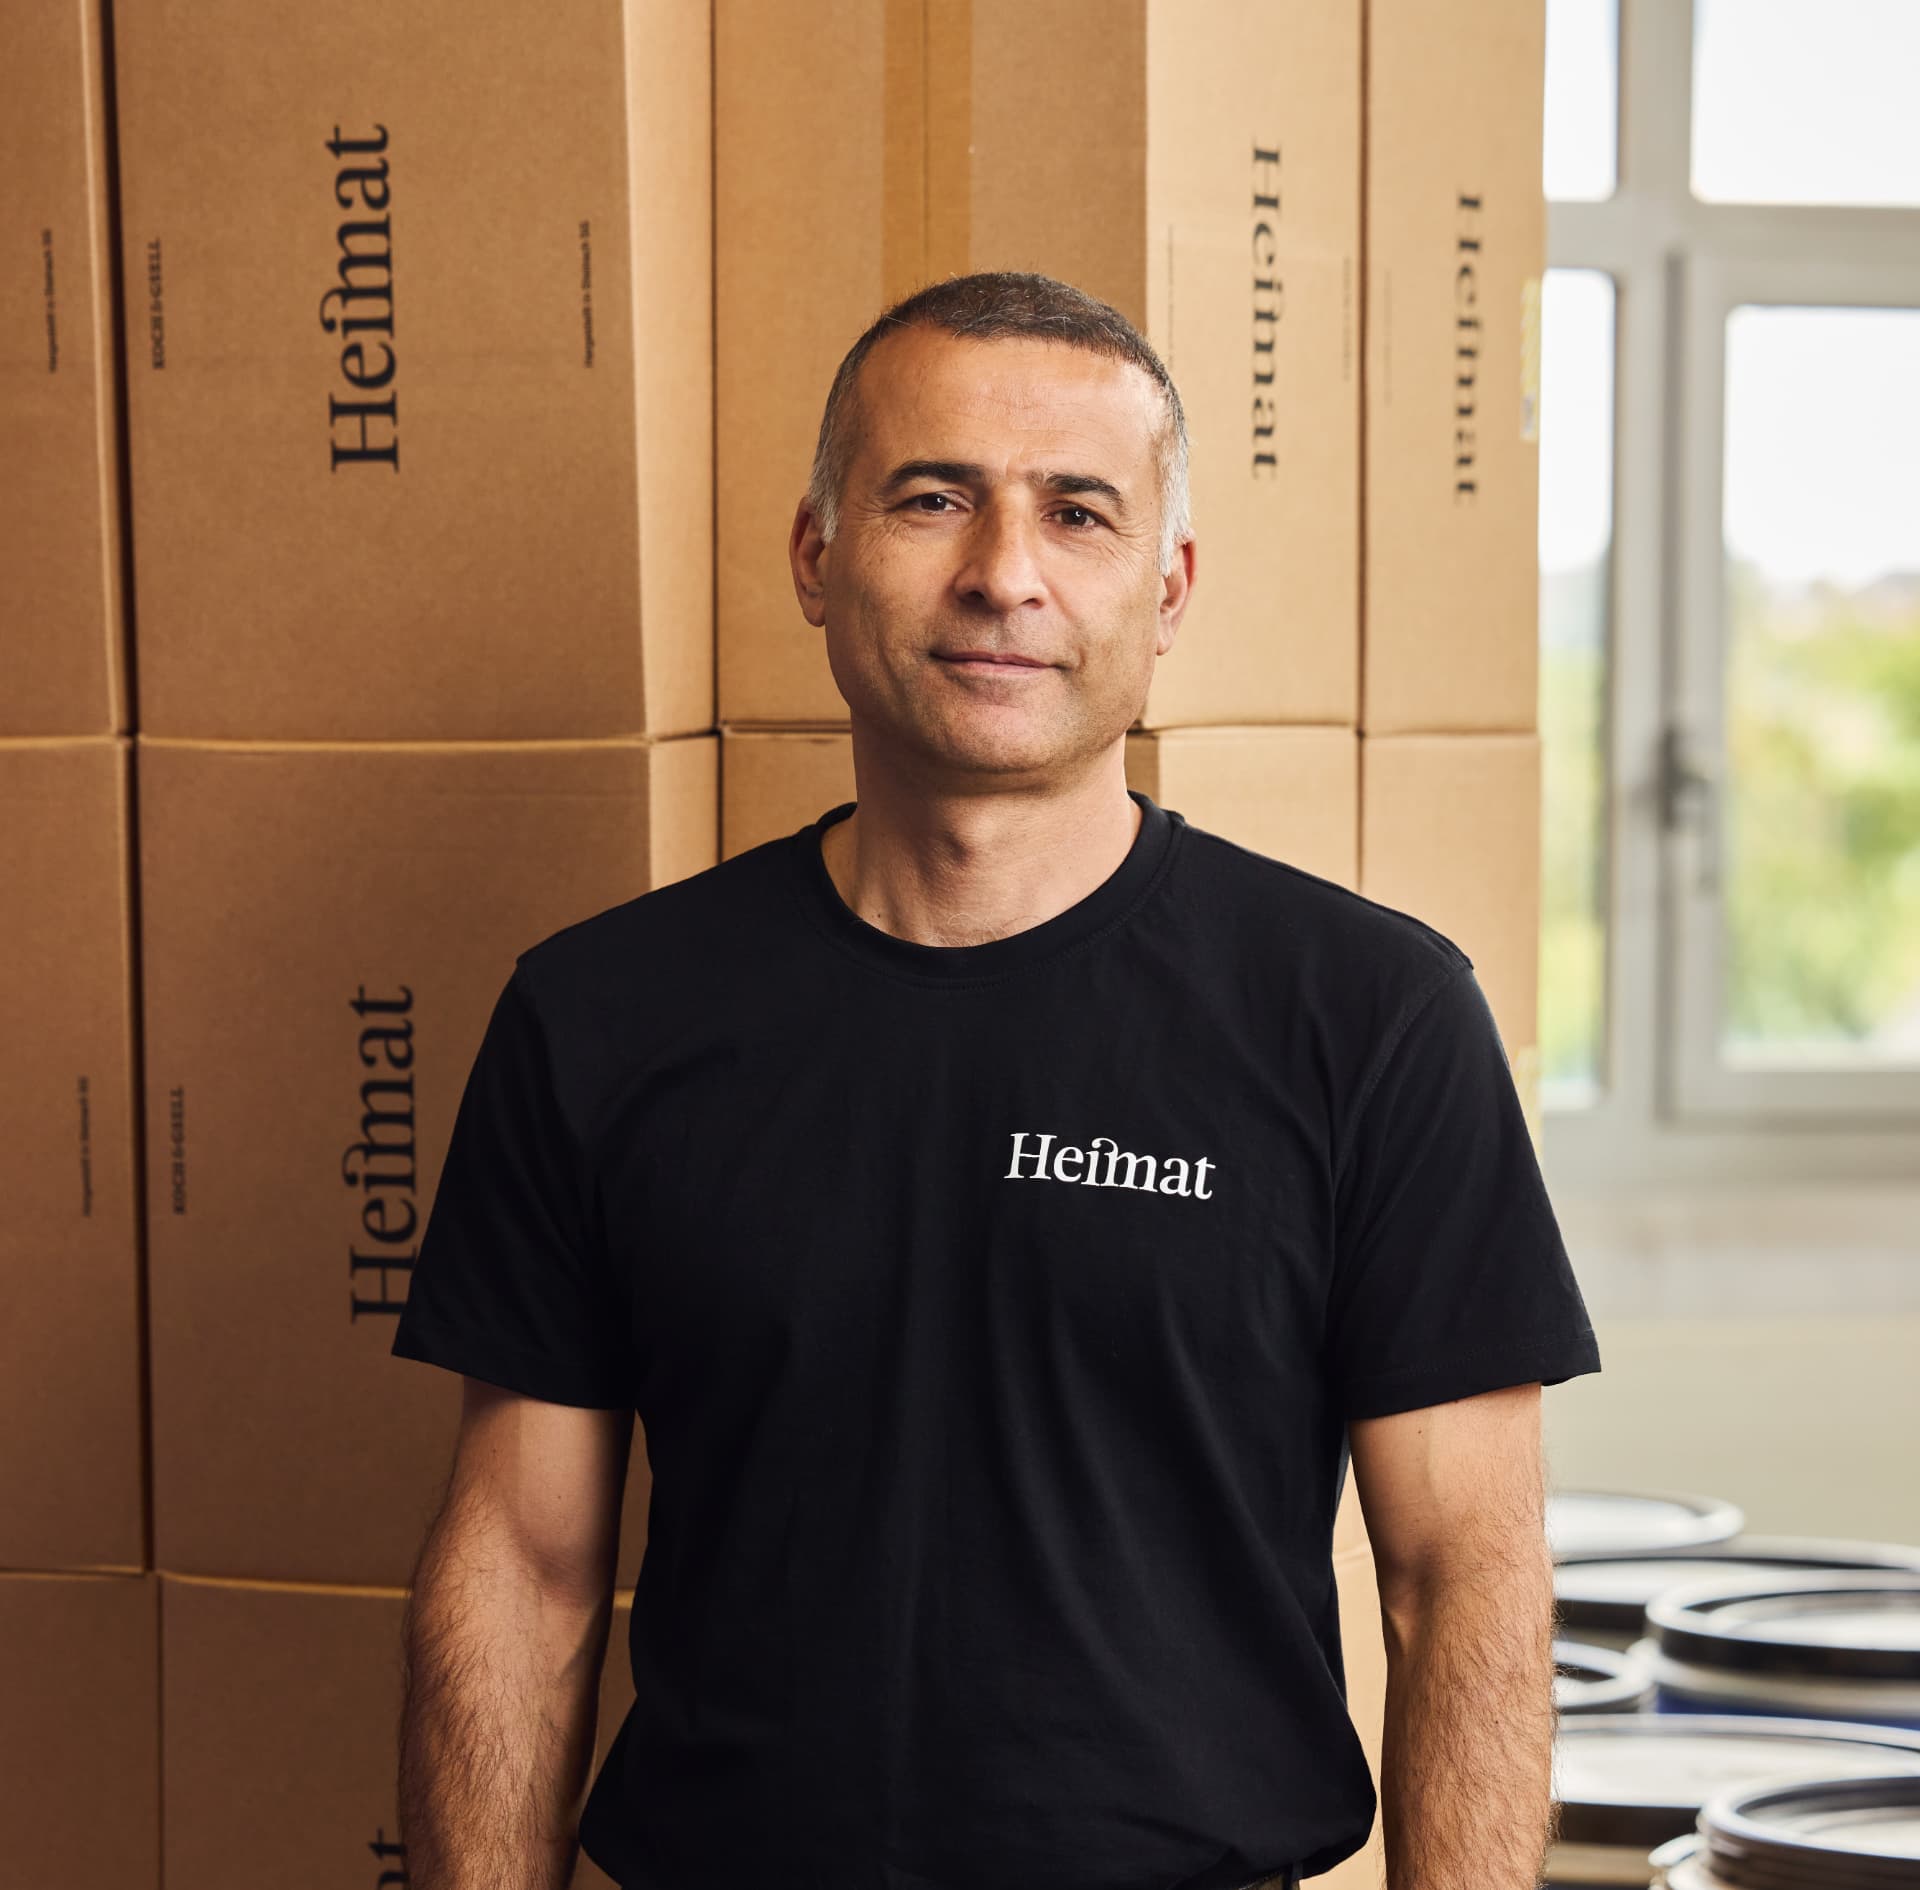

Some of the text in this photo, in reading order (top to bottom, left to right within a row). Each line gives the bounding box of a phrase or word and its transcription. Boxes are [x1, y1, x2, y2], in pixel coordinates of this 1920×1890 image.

[319, 123, 399, 474] Heimat
[1251, 141, 1283, 481] Heimat
[1454, 190, 1483, 505] Heimat
[342, 985, 418, 1324] Heimat
[1003, 1132, 1216, 1200] Heimat
